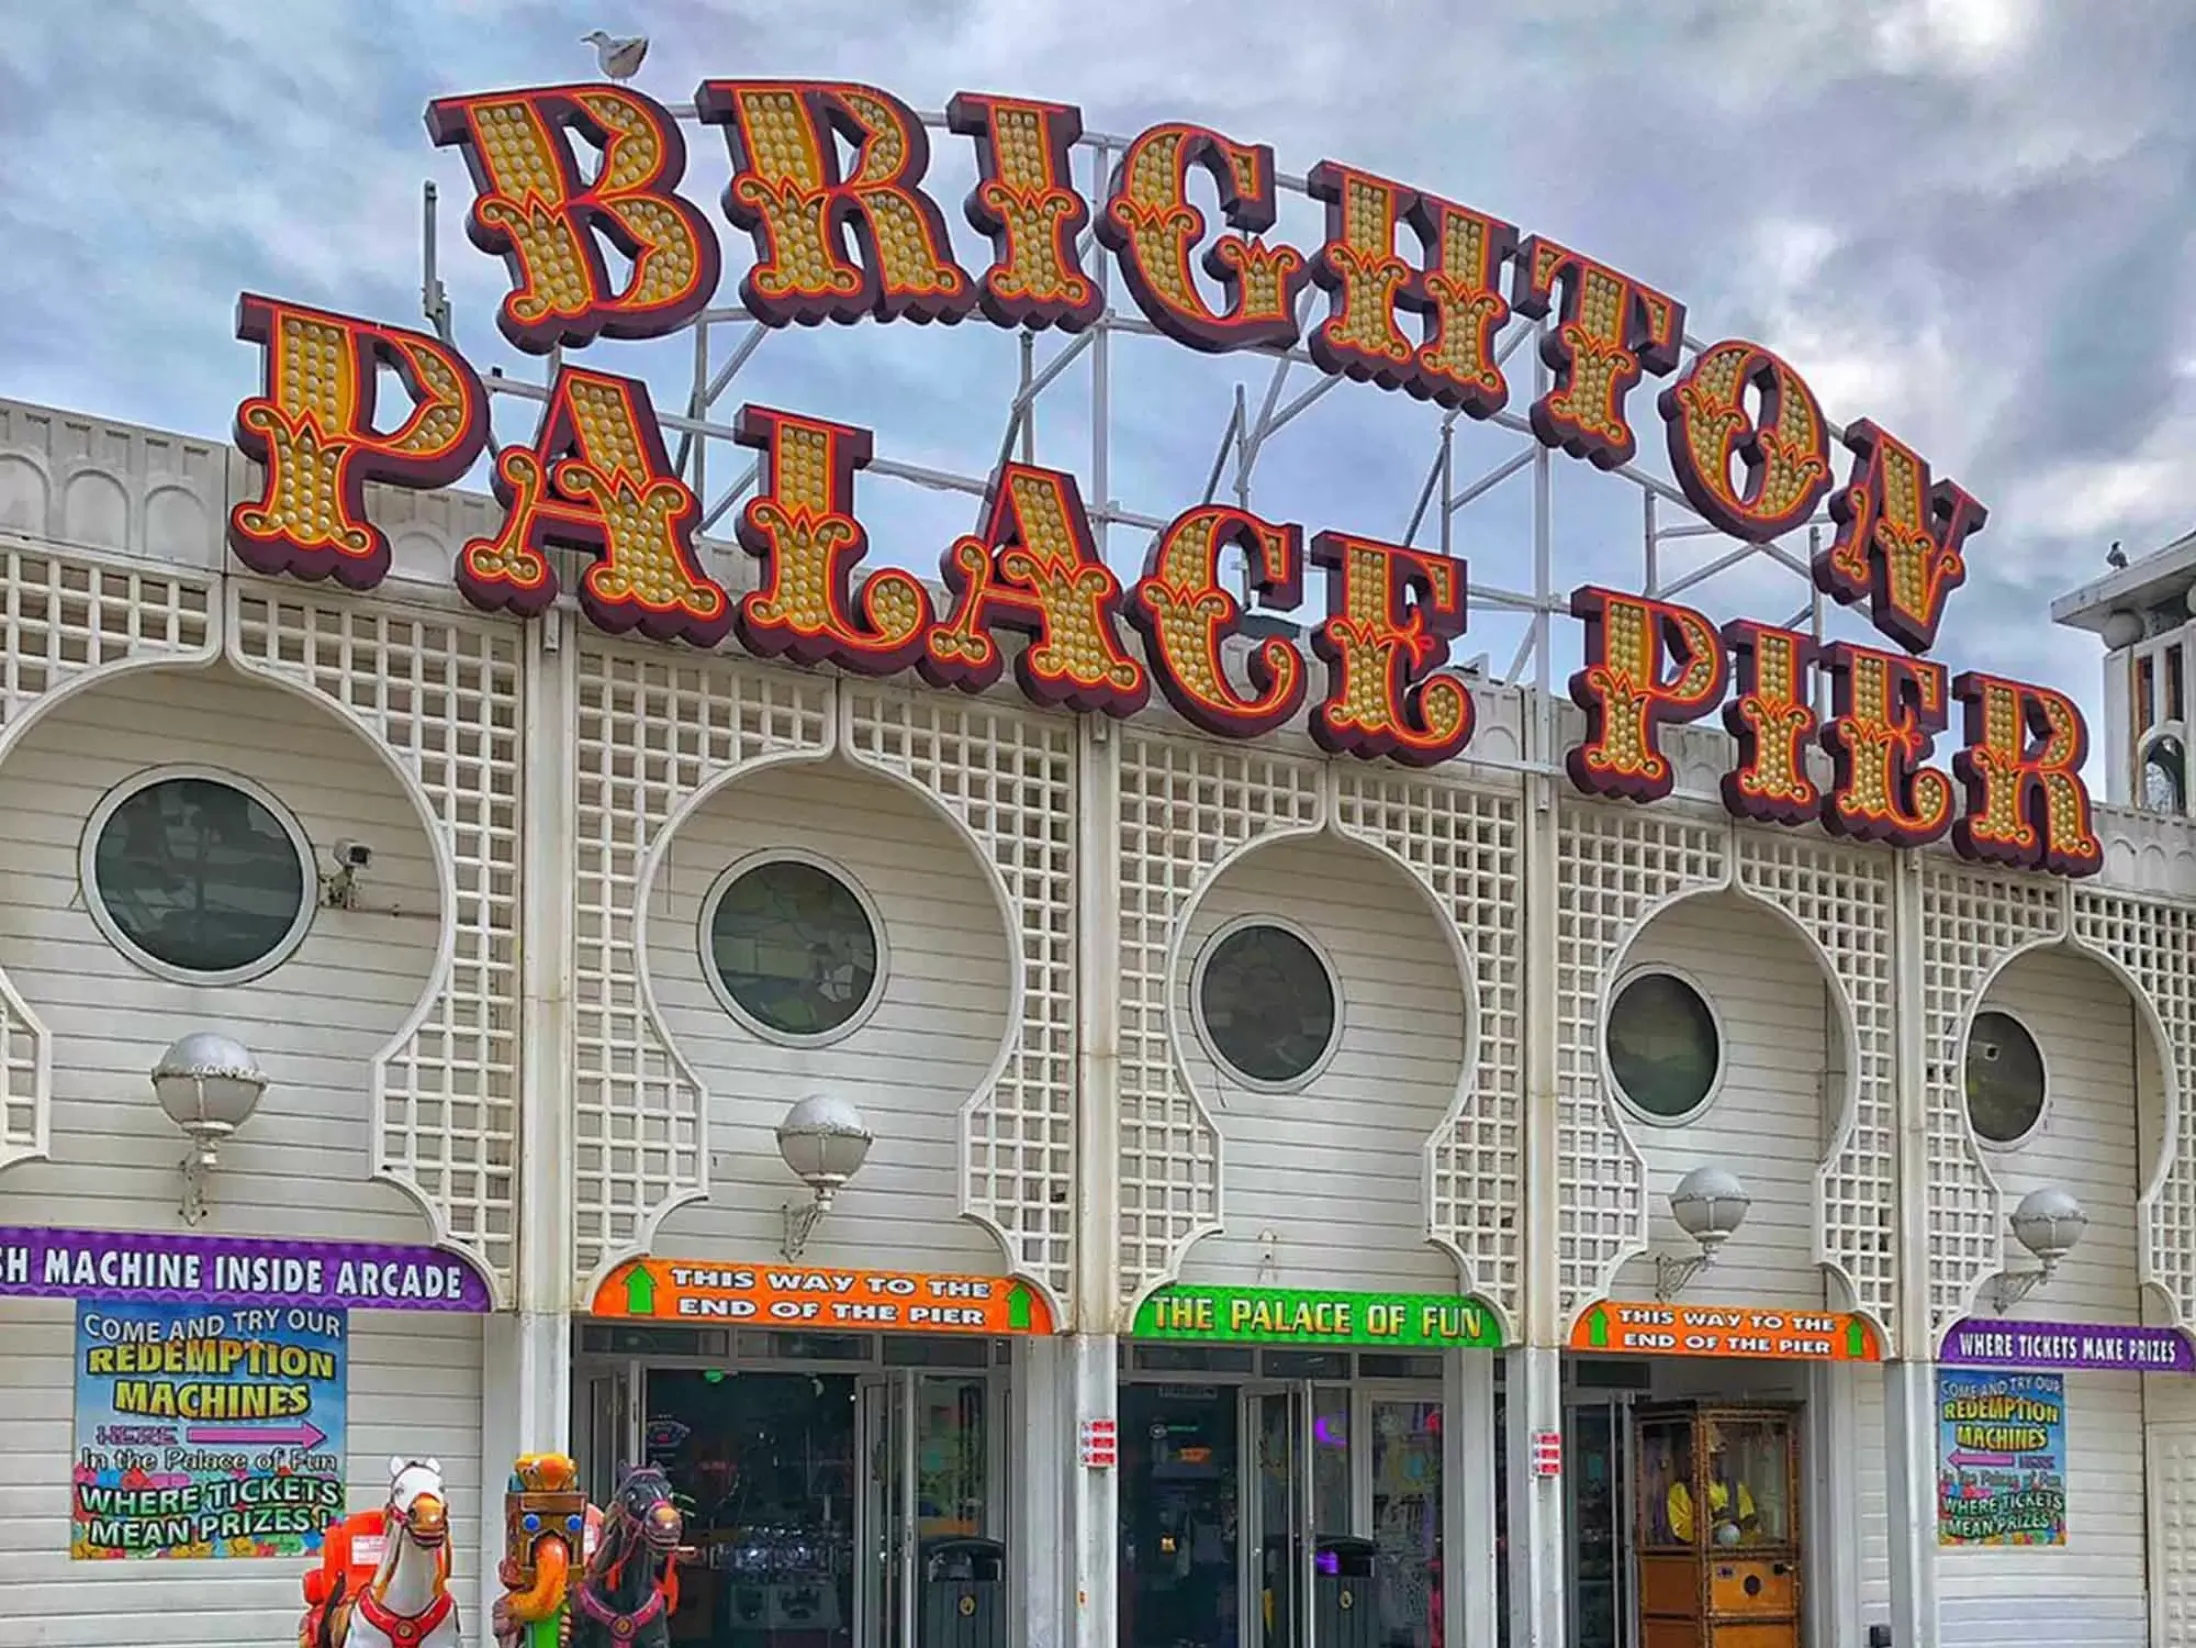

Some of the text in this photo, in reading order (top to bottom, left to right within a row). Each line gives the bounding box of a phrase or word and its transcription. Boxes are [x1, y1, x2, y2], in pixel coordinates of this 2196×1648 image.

[424, 79, 1989, 652] BRIGHTON
[229, 292, 2104, 878] PALACE PIER
[43, 1249, 200, 1288] MACHINE
[215, 1256, 322, 1293] INSIDE
[336, 1261, 462, 1298] ARCADE
[672, 1268, 992, 1298] THIS WAY TO THE
[84, 1308, 341, 1342] COME AND TRY OUR
[678, 1297, 984, 1325] END OF THE PIER
[1152, 1296, 1482, 1338] THE PALACE OF FUN
[1619, 1309, 1836, 1332] THIS WAY TO THE
[1623, 1333, 1831, 1354] END OF THE PIER
[1959, 1333, 2176, 1363] WHERE TICKETS MAKE PRIZES
[88, 1340, 334, 1379] REDEMPTION
[114, 1381, 311, 1419] MACHINES
[1943, 1398, 2060, 1423] REDEMPTION
[1956, 1425, 2048, 1450] MACHINES
[81, 1449, 338, 1472] In the Palace of Fun
[80, 1478, 341, 1515] WHERE TICKETS
[91, 1518, 191, 1549] MEAN
